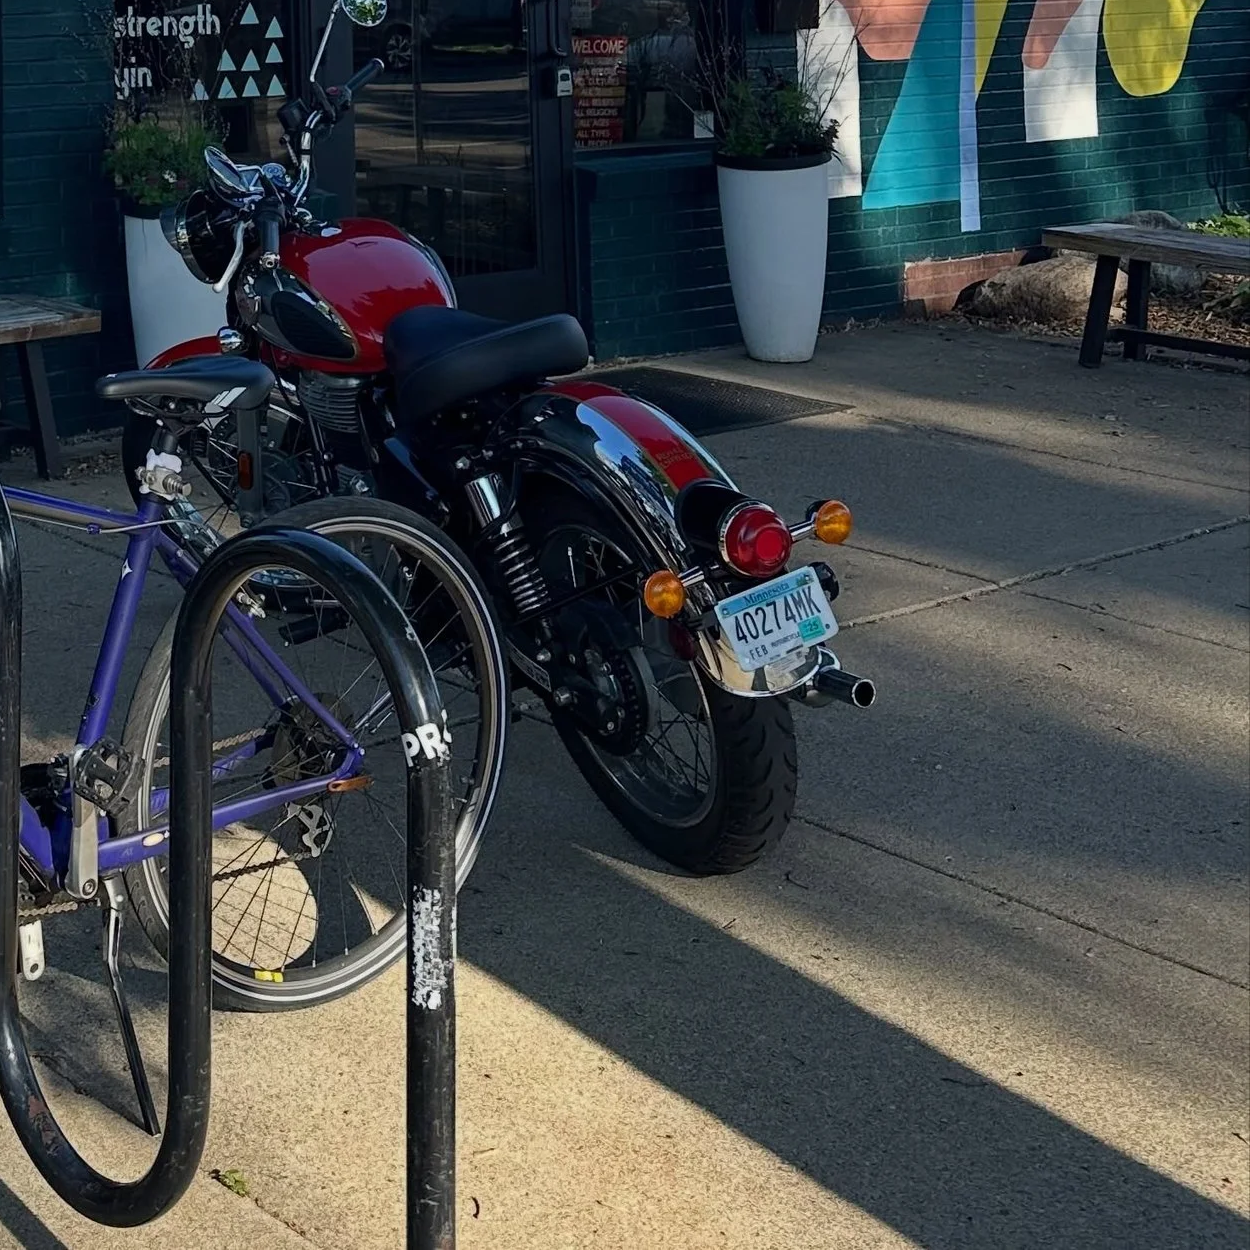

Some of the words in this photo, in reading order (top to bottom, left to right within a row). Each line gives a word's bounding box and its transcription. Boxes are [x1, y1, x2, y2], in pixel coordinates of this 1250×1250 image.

[113, 3, 221, 49] strength
[572, 38, 625, 54] WELCOME
[114, 56, 153, 101] yin
[578, 98, 590, 107] ALL
[574, 108, 584, 117] ALL
[577, 129, 589, 138] ALL
[591, 129, 610, 138] TYPES
[743, 581, 790, 606] Minnesota
[734, 586, 822, 644] 40274MK
[749, 644, 769, 660] FEB
